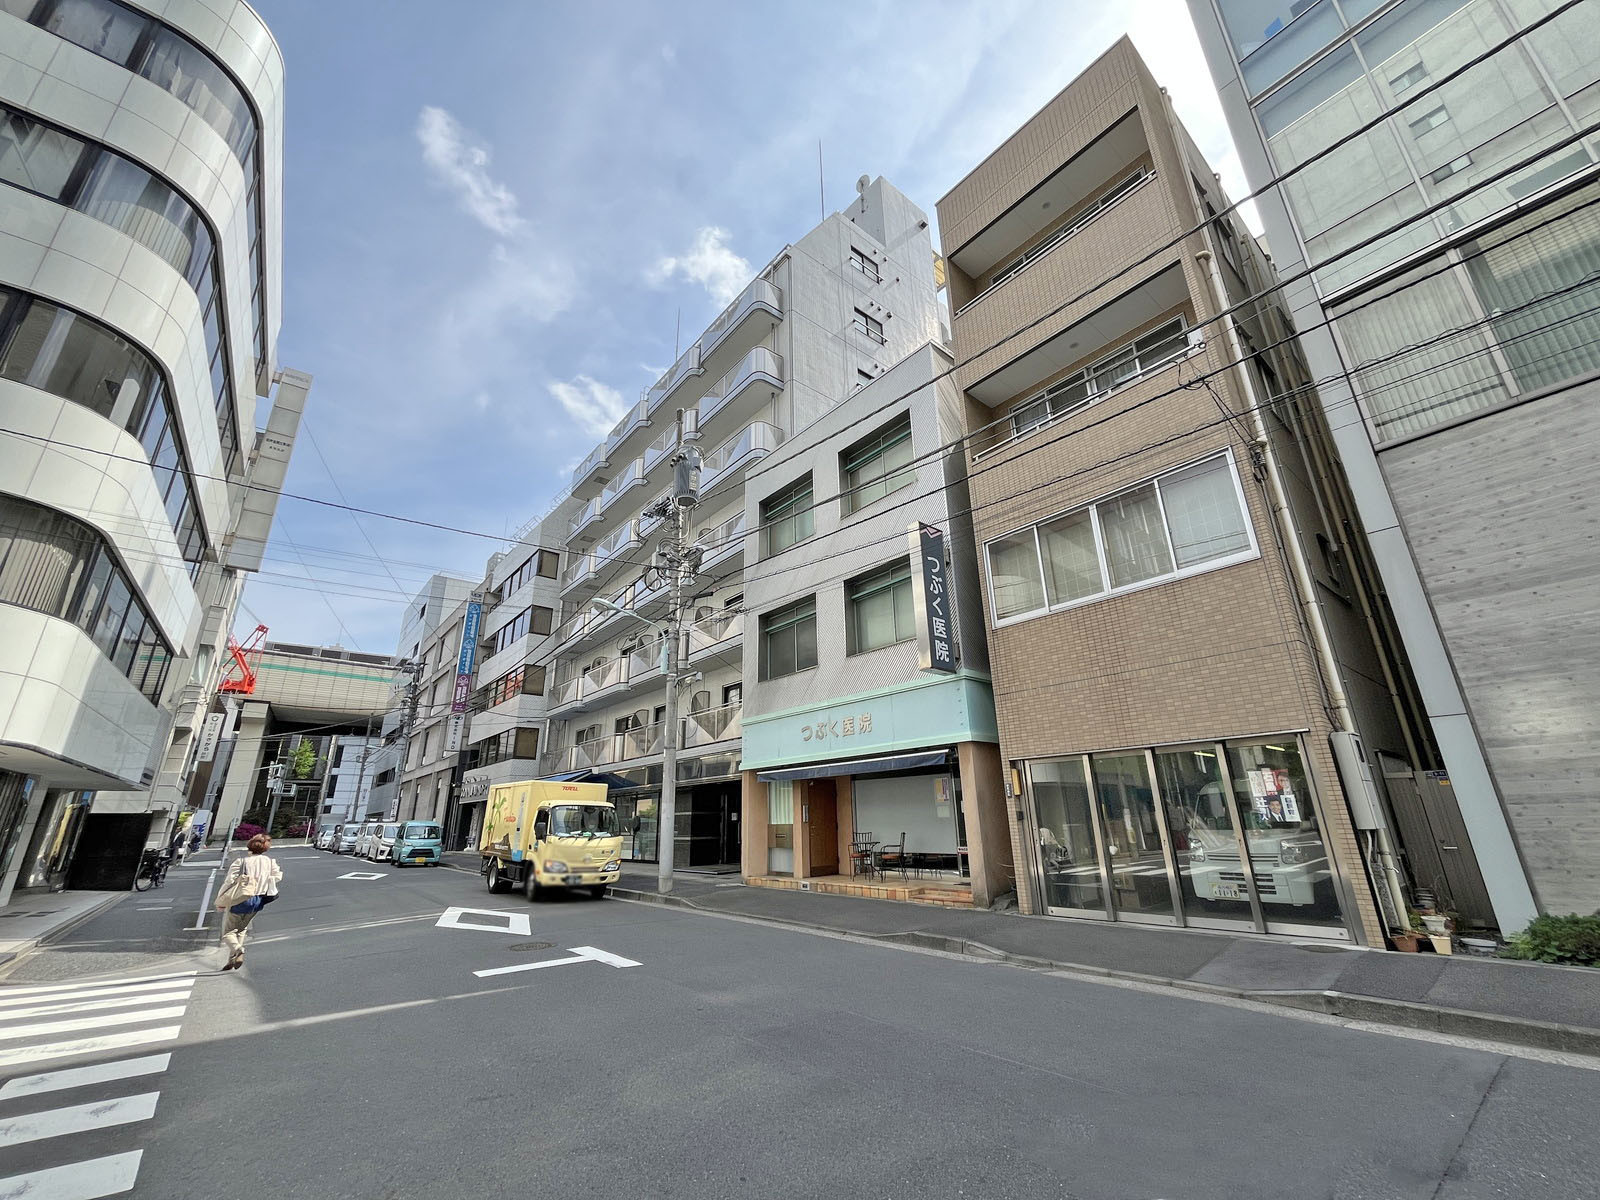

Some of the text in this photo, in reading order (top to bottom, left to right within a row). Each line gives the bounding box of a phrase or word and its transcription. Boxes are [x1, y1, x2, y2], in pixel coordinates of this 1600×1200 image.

[927, 556, 949, 662] つぶく医院
[801, 712, 872, 741] つぶく医院
